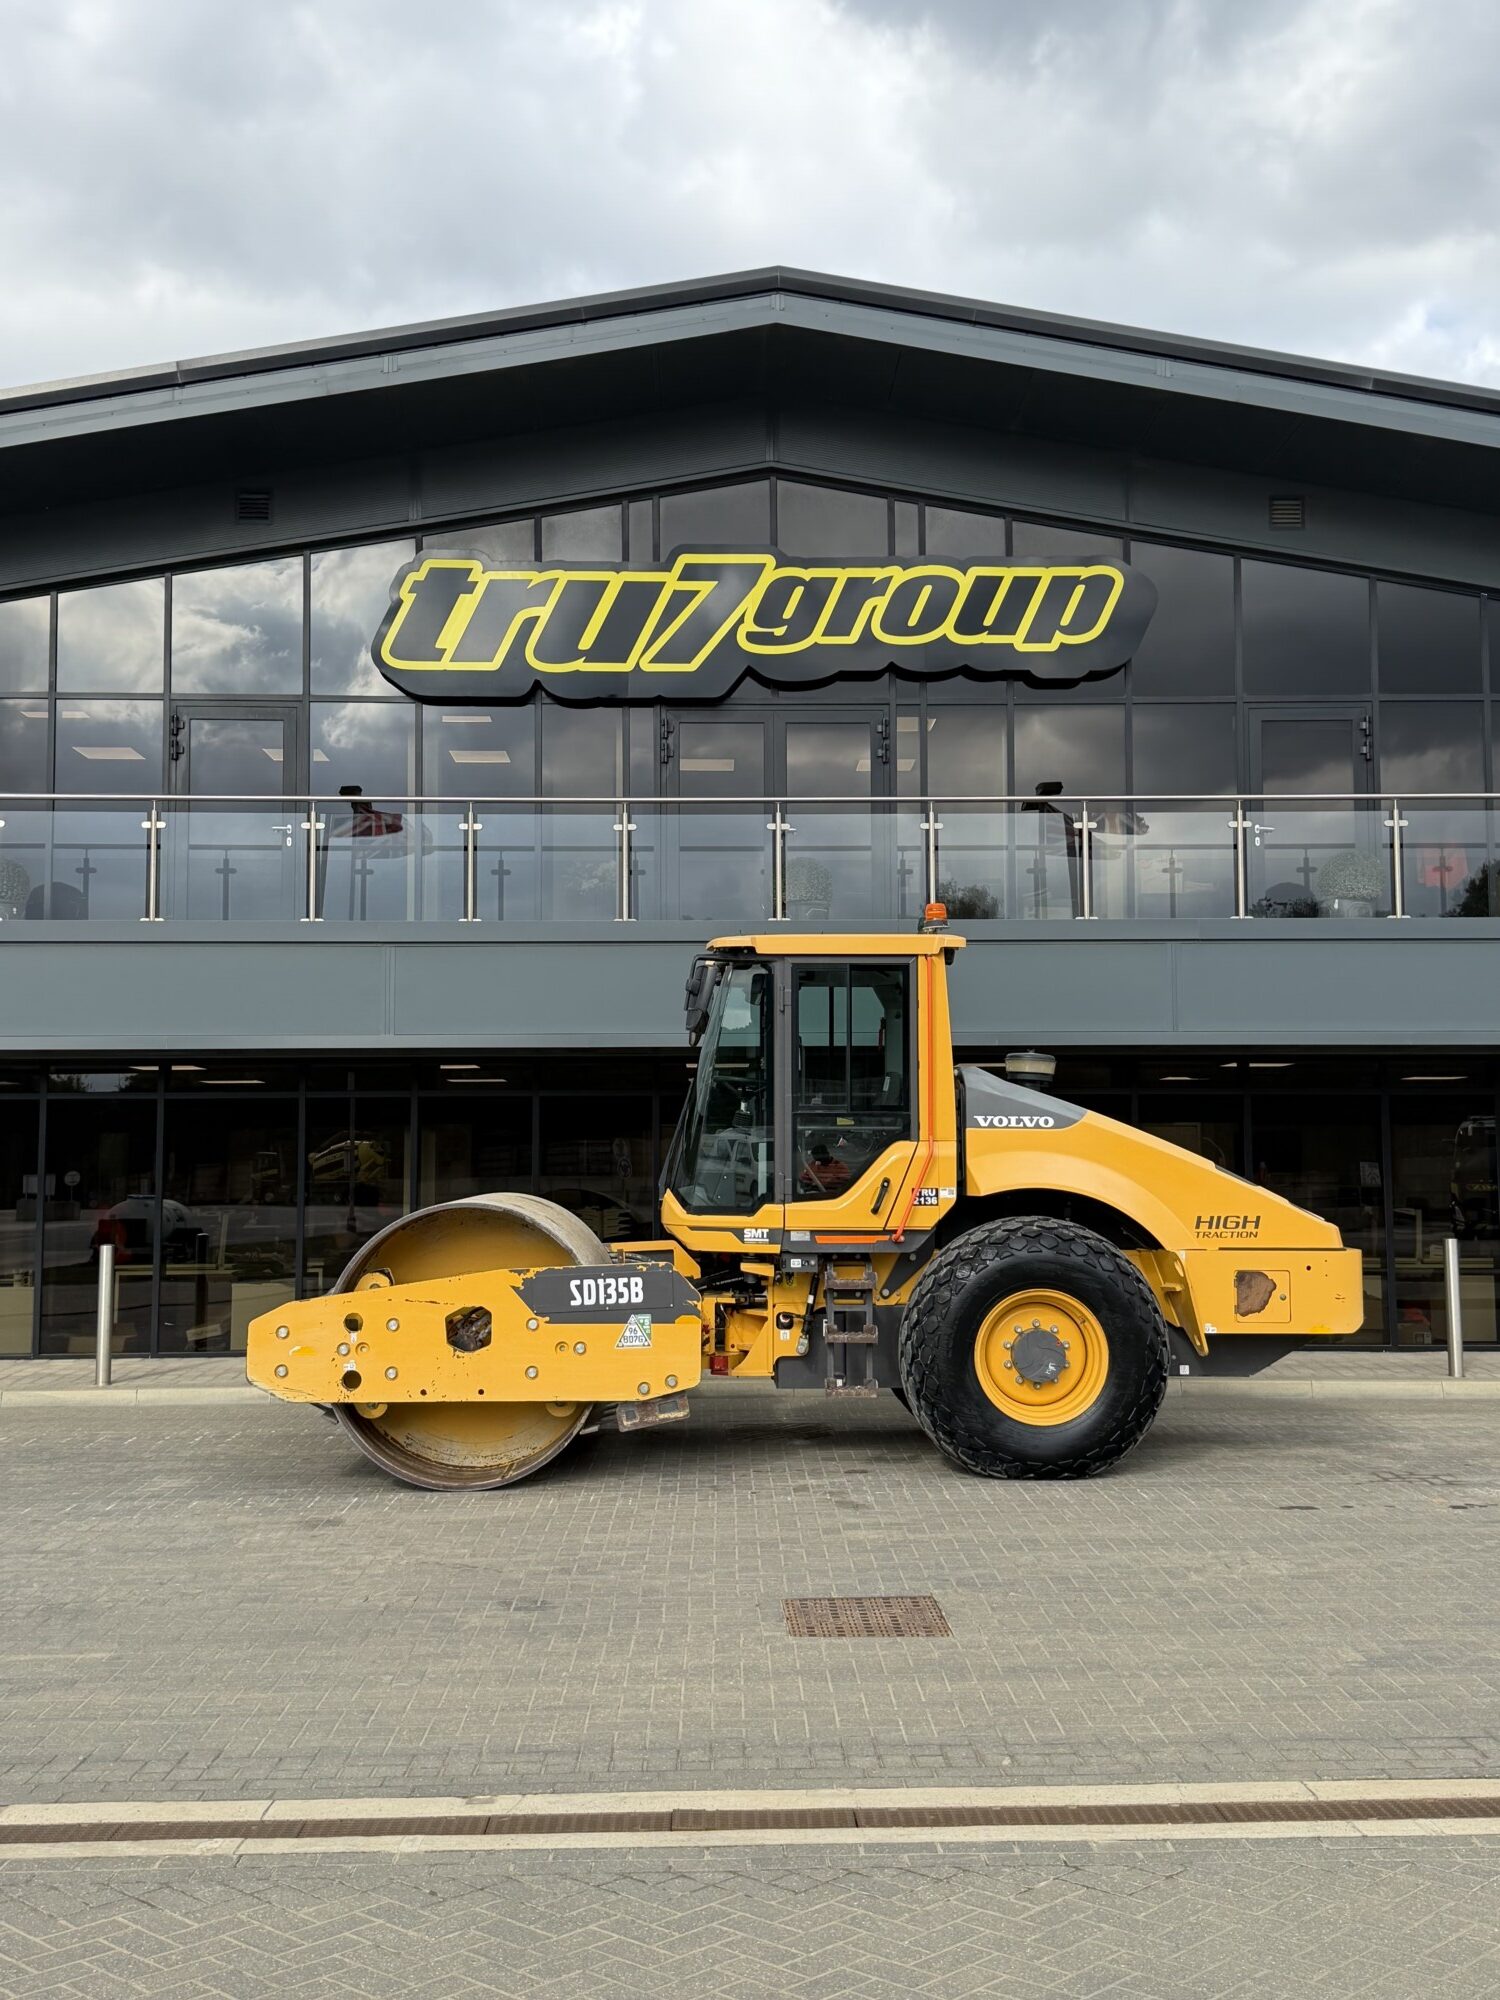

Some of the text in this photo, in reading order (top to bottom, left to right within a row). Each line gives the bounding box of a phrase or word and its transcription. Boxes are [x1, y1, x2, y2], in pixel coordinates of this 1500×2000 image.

[974, 1115, 1055, 1128] VOLVO
[913, 1197, 938, 1205] 2136
[1195, 1215, 1261, 1229] HIGH
[744, 1228, 769, 1238] SMT
[1195, 1231, 1258, 1239] TRACTION
[569, 1277, 644, 1306] SD135B
[628, 1327, 638, 1335] 96
